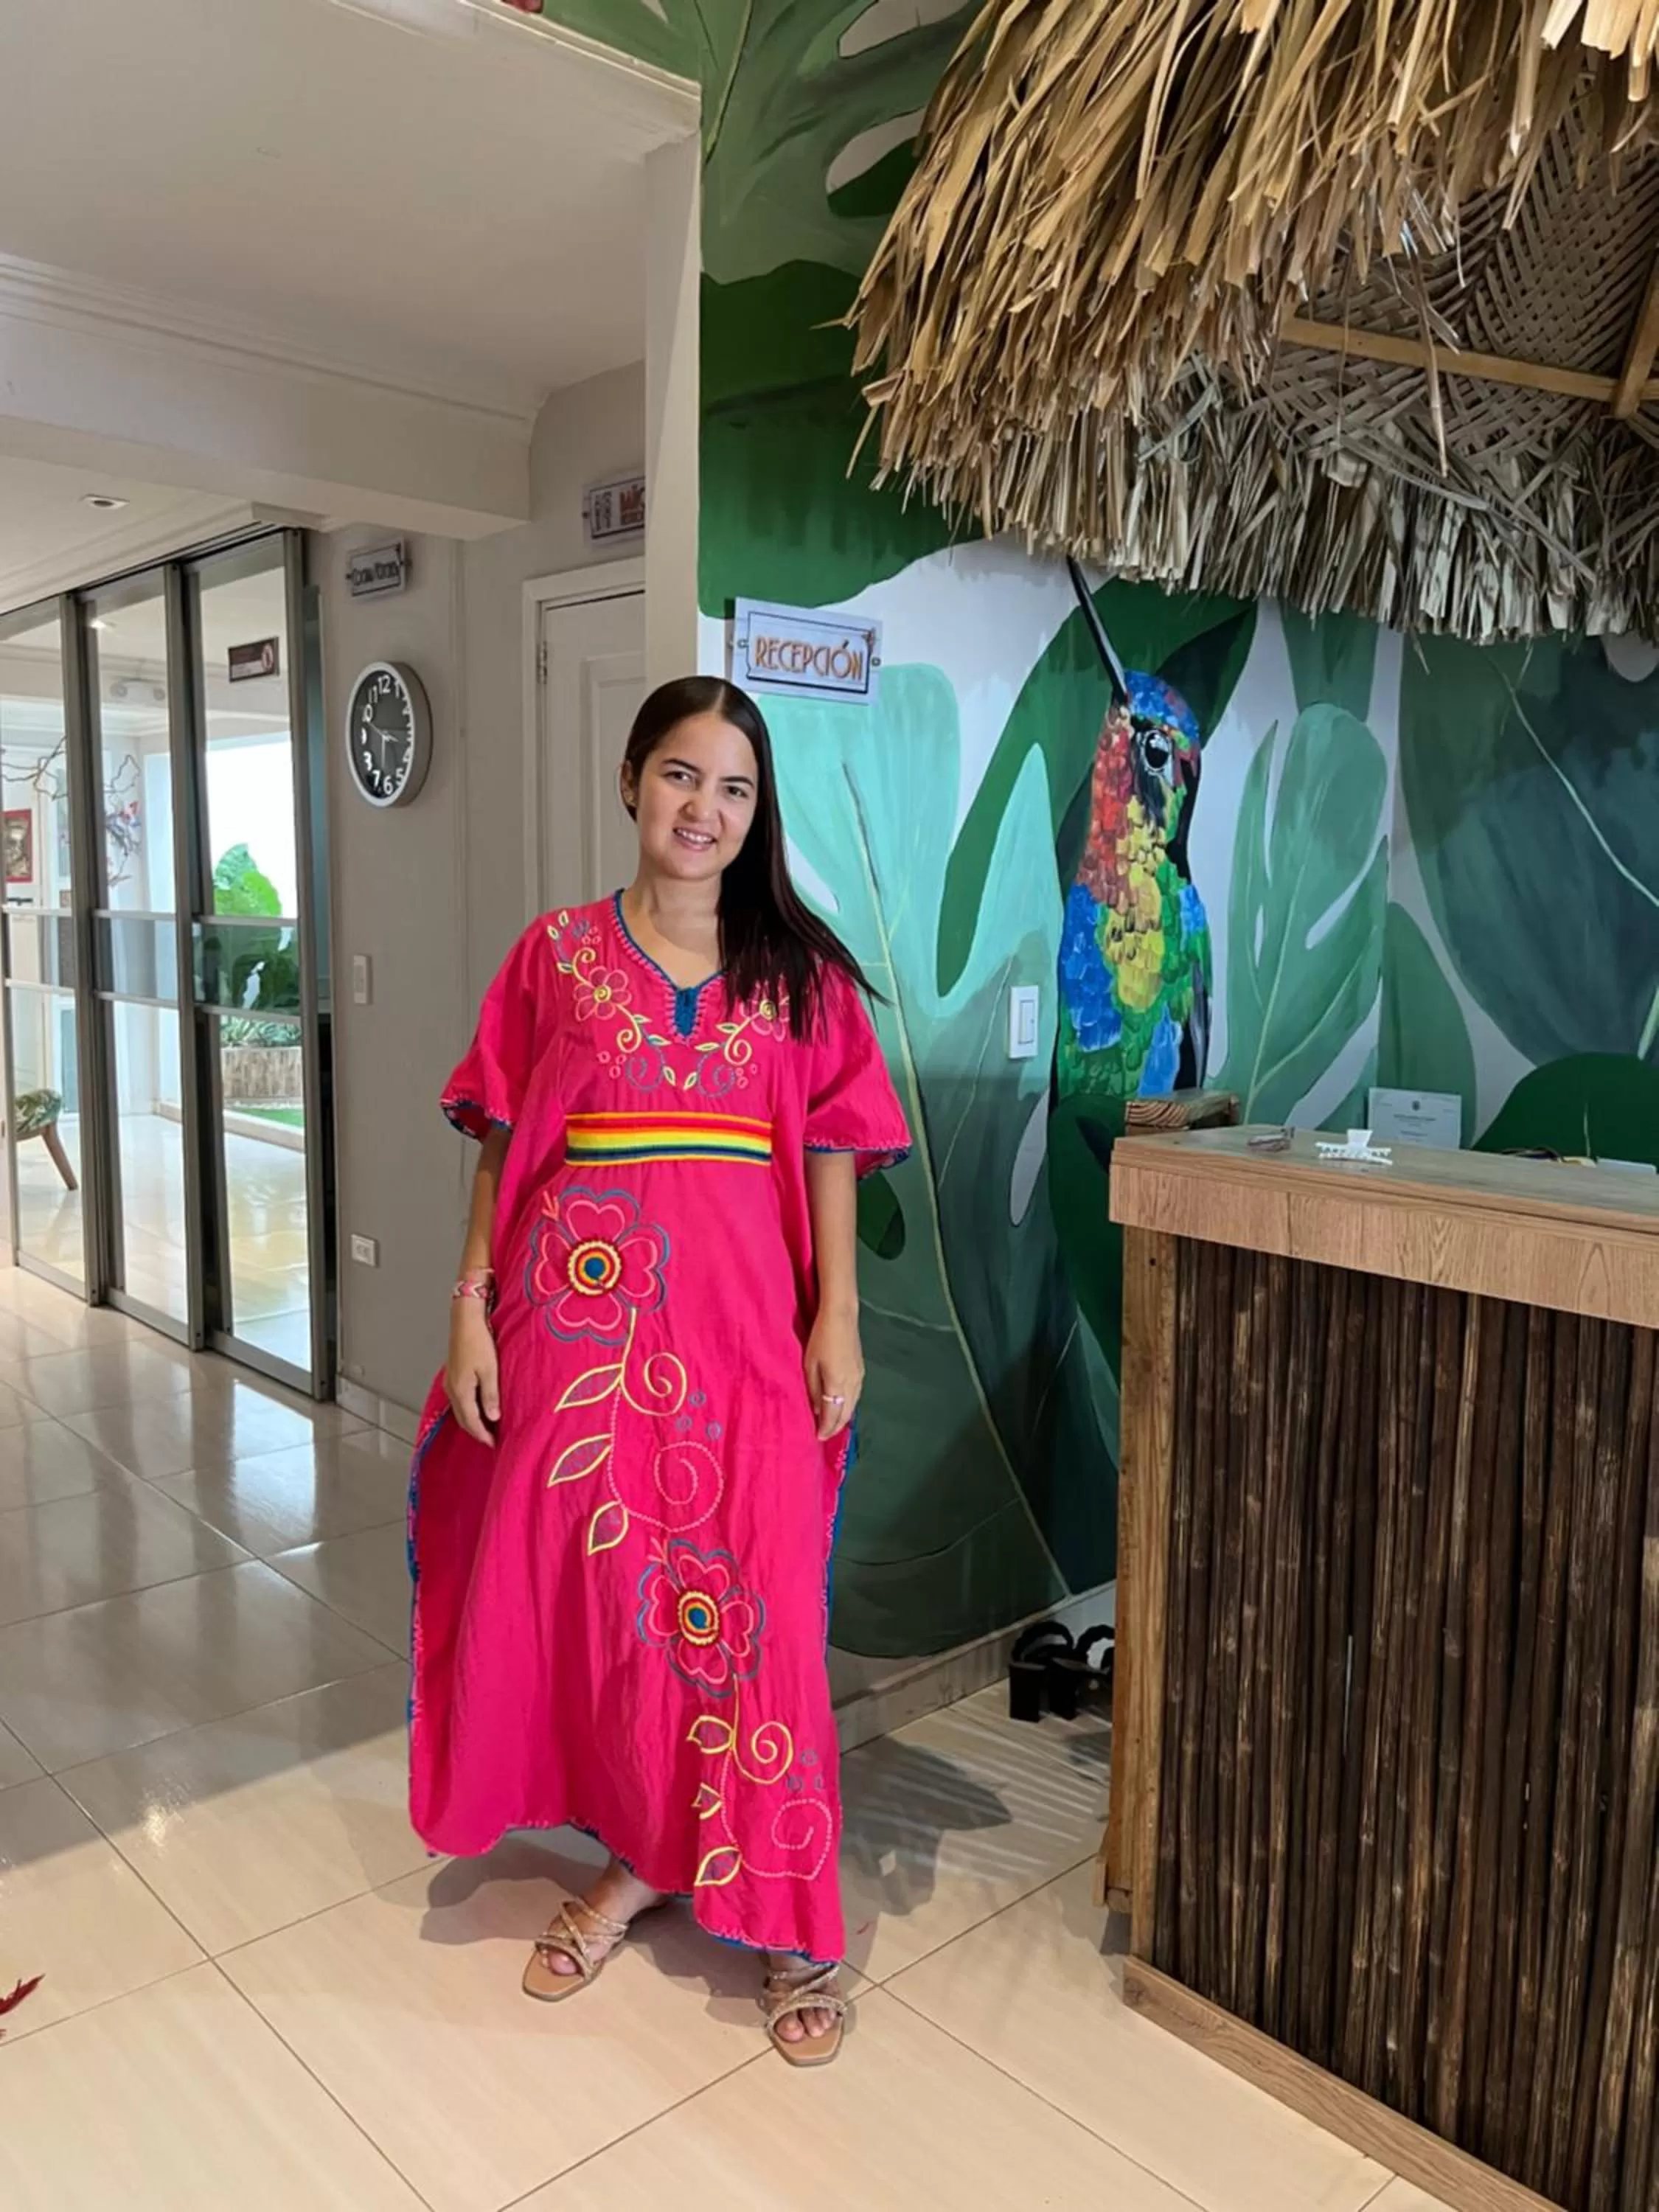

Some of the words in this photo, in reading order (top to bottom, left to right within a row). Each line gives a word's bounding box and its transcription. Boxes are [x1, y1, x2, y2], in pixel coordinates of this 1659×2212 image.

[755, 636, 863, 681] RECEPCIÓN
[378, 675, 391, 694] 12
[372, 770, 380, 787] 7
[383, 776, 394, 795] 6
